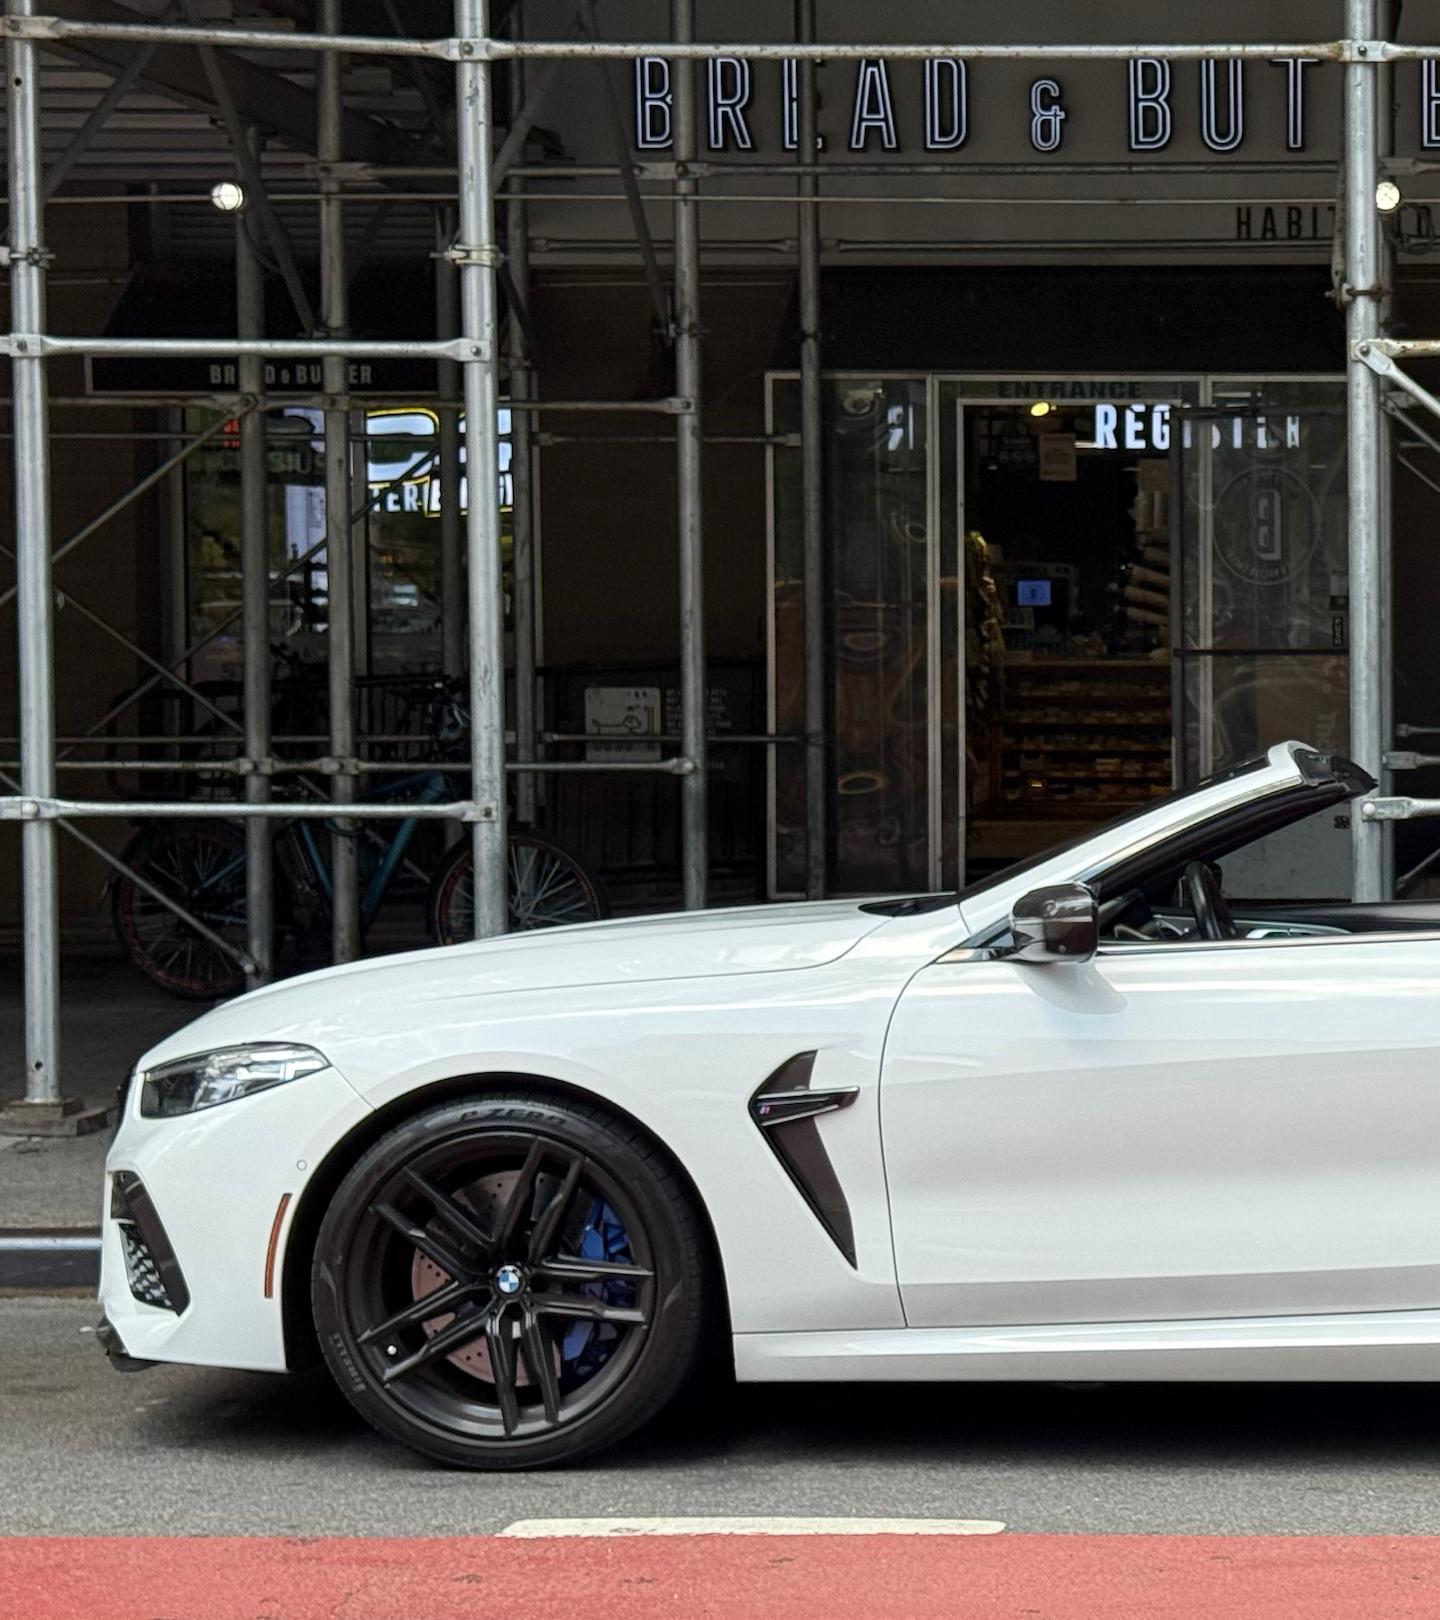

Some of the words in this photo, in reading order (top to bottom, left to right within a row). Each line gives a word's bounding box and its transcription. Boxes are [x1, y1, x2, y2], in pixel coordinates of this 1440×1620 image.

[1030, 78, 1066, 152] &
[209, 364, 276, 385] BRD
[296, 364, 373, 385] BUER
[999, 381, 1141, 399] ENTRANCE
